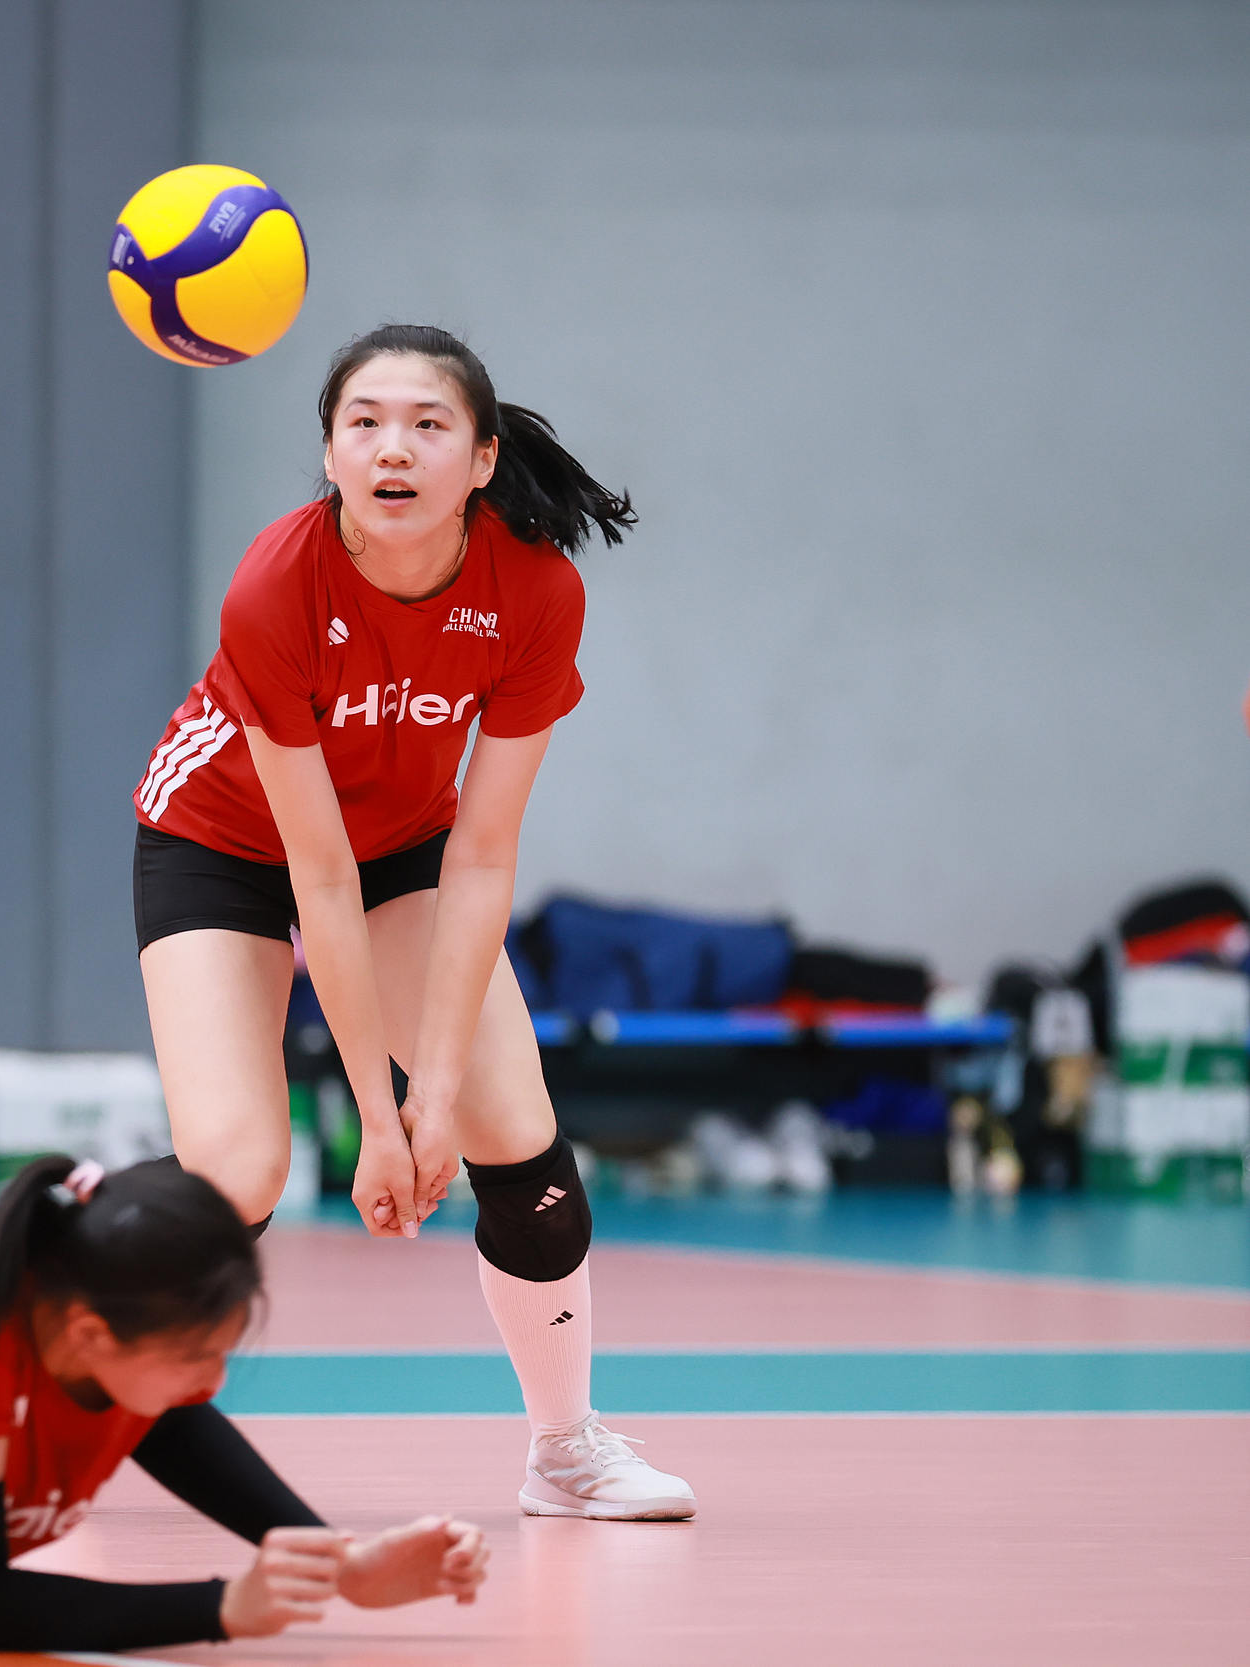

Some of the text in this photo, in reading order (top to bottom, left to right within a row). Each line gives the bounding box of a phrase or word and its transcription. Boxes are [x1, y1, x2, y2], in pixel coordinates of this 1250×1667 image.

[208, 201, 237, 234] FIVB
[449, 607, 498, 629] CHINA
[331, 677, 474, 728] Haier
